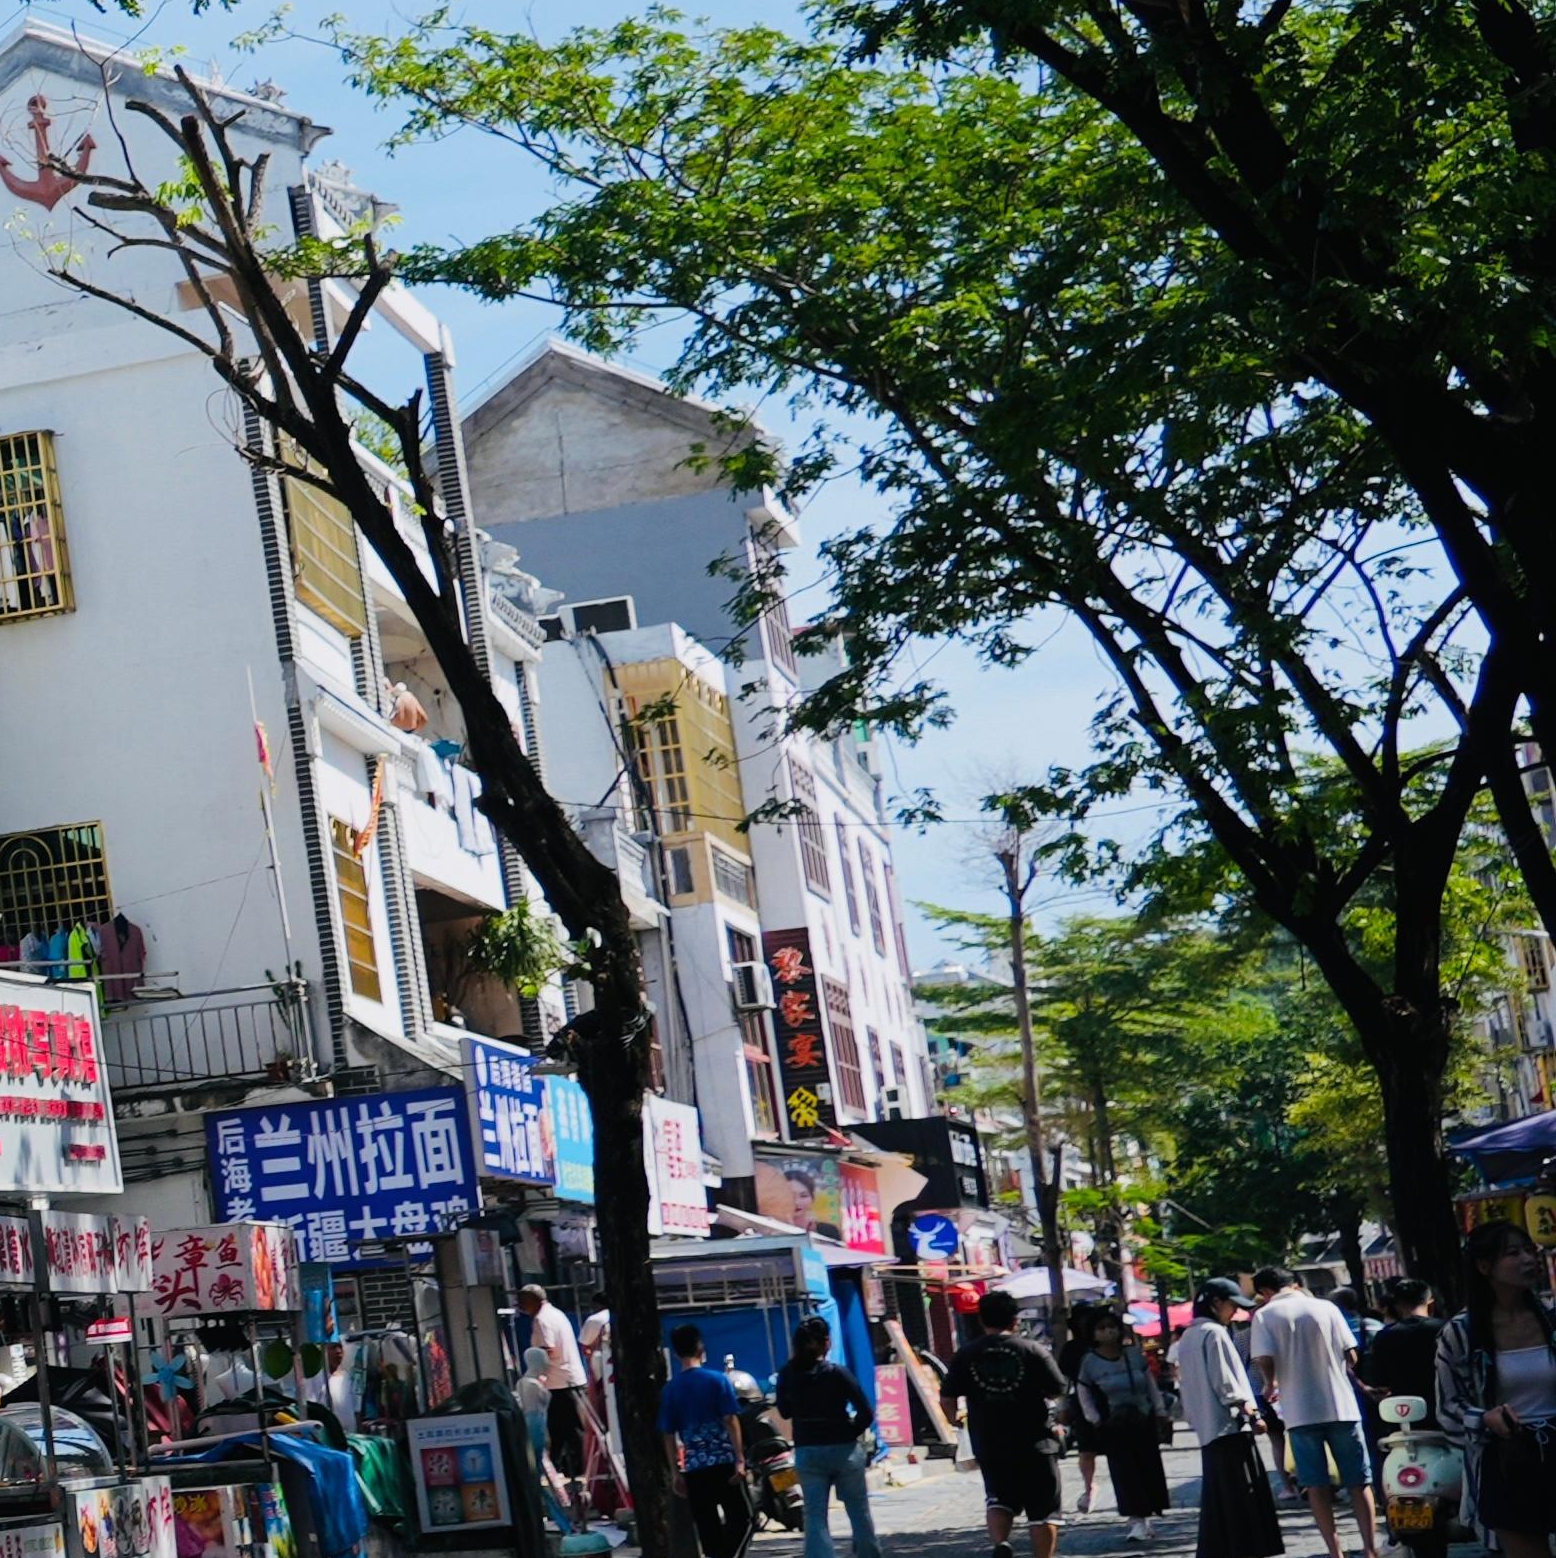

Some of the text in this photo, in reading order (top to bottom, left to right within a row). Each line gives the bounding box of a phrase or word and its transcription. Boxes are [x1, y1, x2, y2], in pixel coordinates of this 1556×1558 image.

[254, 1098, 465, 1202] 兰州拉面
[479, 1090, 545, 1178] 兰州拉面
